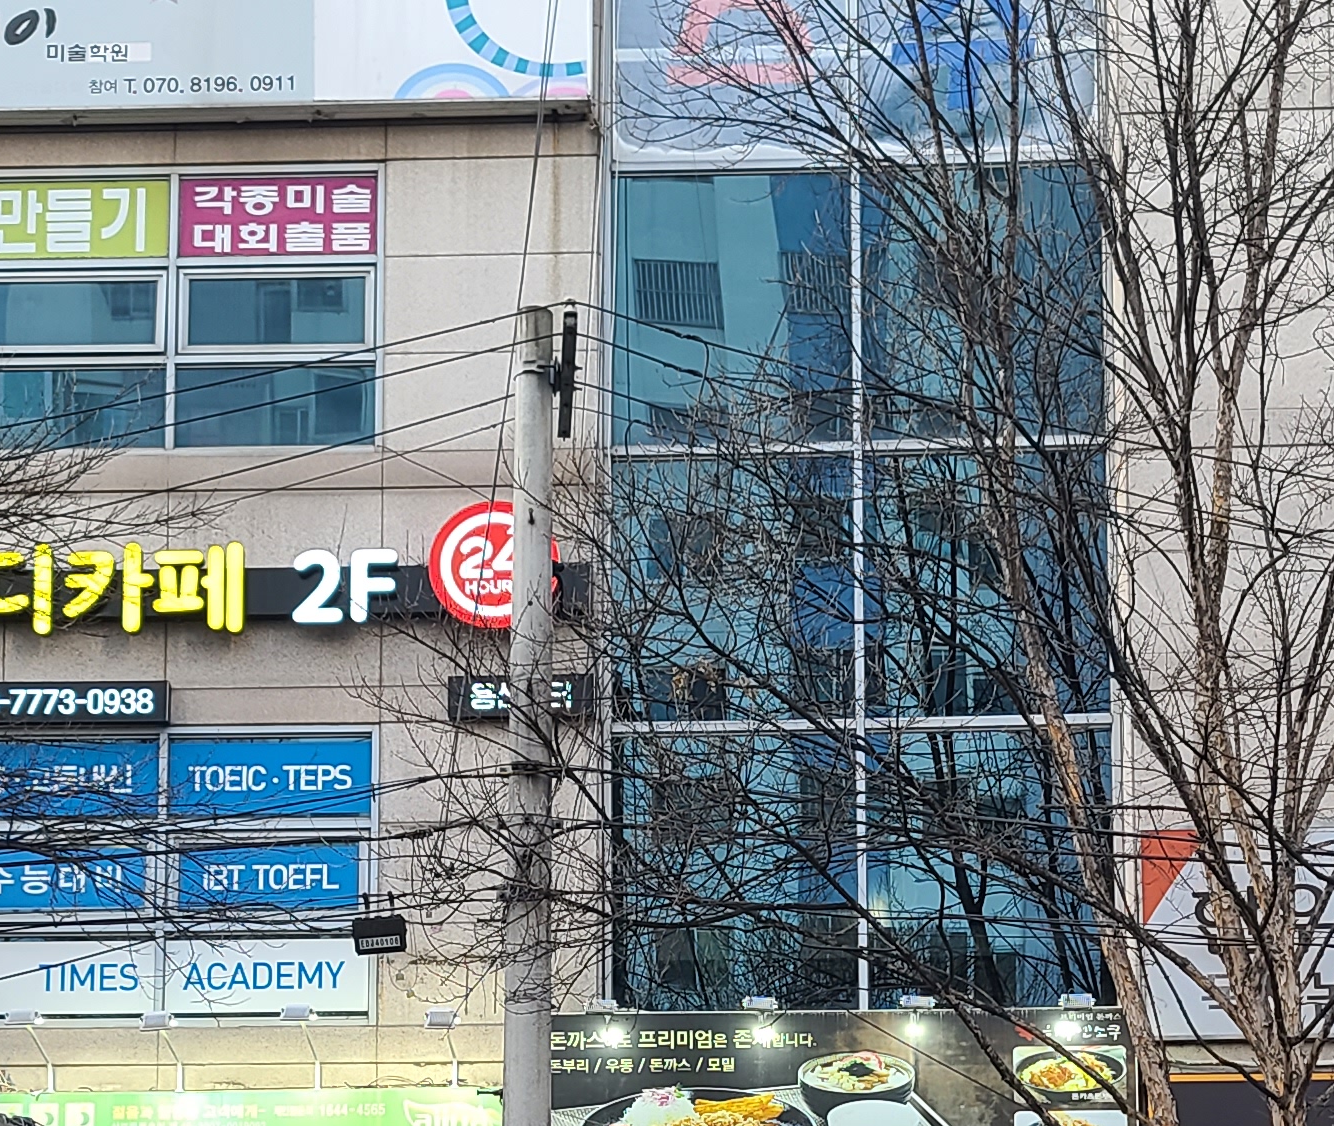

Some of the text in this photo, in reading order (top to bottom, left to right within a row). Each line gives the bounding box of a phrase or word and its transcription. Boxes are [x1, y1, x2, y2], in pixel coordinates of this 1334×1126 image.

[45, 41, 129, 64] 미술학원
[87, 77, 120, 96] 참여
[248, 74, 298, 93] 0911
[193, 182, 372, 217] 각종미술
[192, 221, 372, 254] 대회출품
[291, 547, 399, 625] 2F
[251, 864, 340, 890] TOEFL
[39, 961, 346, 992] TIMES ACADEMY
[637, 1029, 728, 1050] 프리미엄은
[550, 1059, 590, 1074] 돈부리
[604, 1059, 635, 1074] 우동
[648, 1058, 693, 1073] 돈까스
